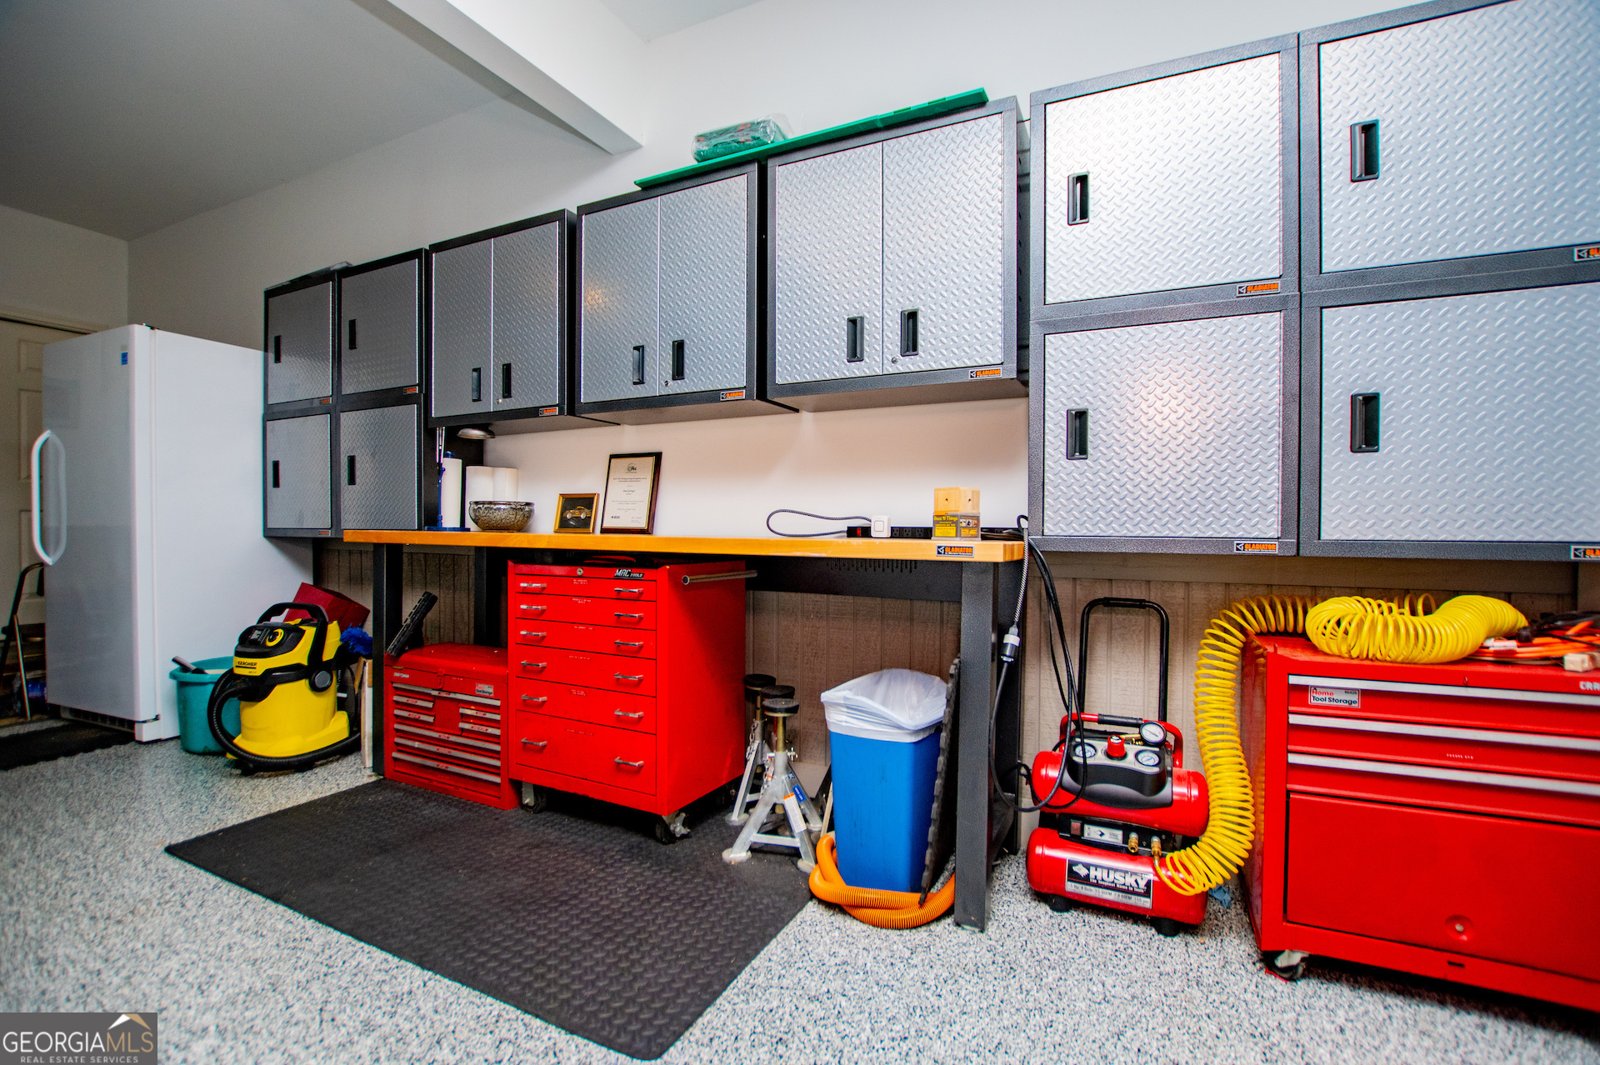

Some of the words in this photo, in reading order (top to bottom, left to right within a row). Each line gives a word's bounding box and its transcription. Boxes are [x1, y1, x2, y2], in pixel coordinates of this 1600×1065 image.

[1312, 695, 1327, 703] Tool
[1328, 696, 1358, 706] Storage
[1089, 865, 1150, 889] HUSKY
